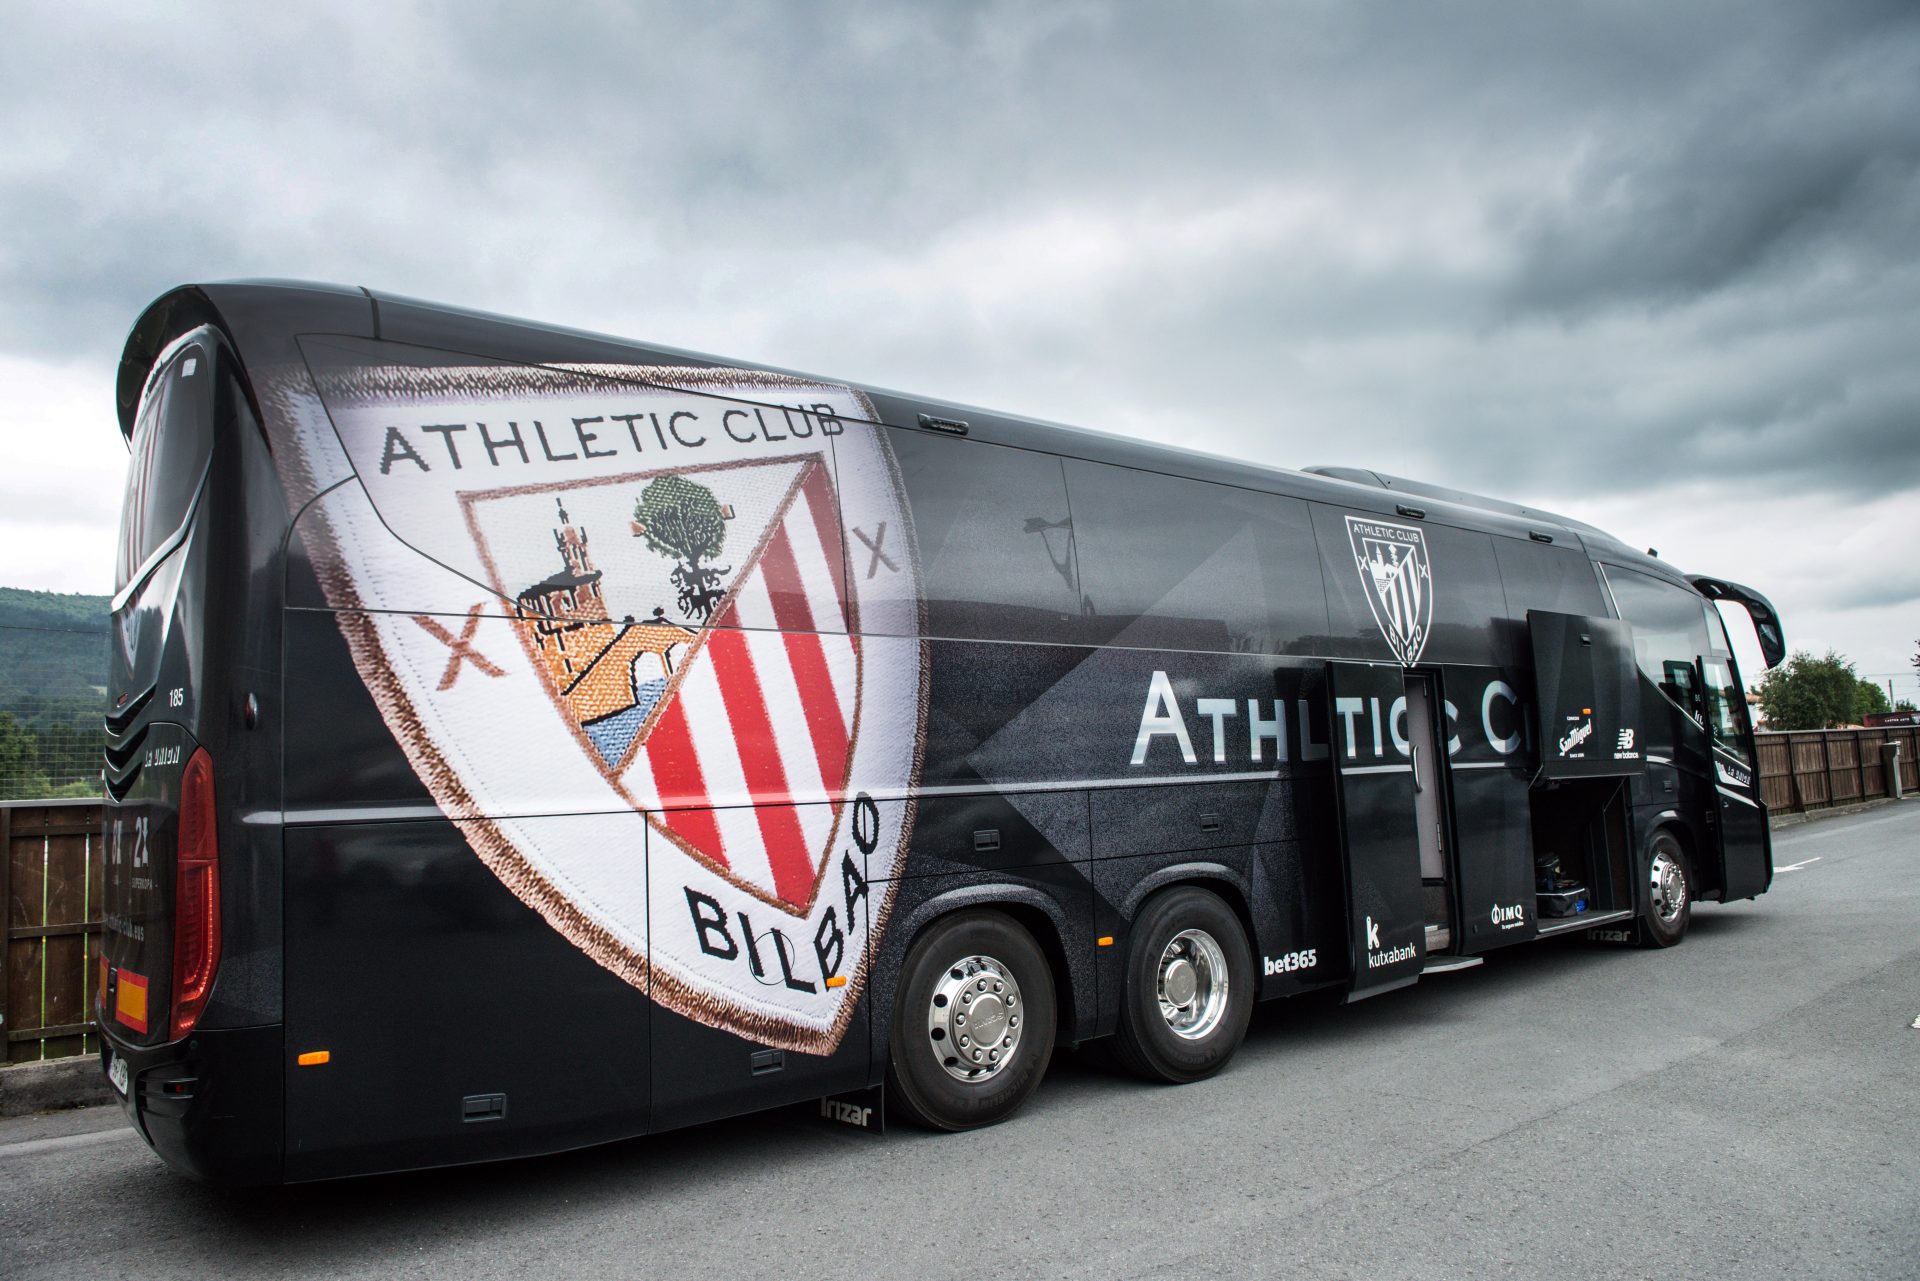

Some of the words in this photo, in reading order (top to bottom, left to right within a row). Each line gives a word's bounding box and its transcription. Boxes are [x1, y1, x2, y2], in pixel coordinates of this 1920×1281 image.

[380, 410, 707, 475] ATHLETIC
[722, 403, 846, 443] CLUB
[1353, 523, 1395, 539] ATHLETIC
[1396, 530, 1420, 543] CLUB
[1388, 623, 1422, 664] BILBAO
[169, 687, 184, 708] 185
[683, 791, 880, 995] BILBAO
[1500, 904, 1524, 922] IMQ
[1263, 948, 1317, 976] bet365
[1368, 942, 1417, 969] kutxabank
